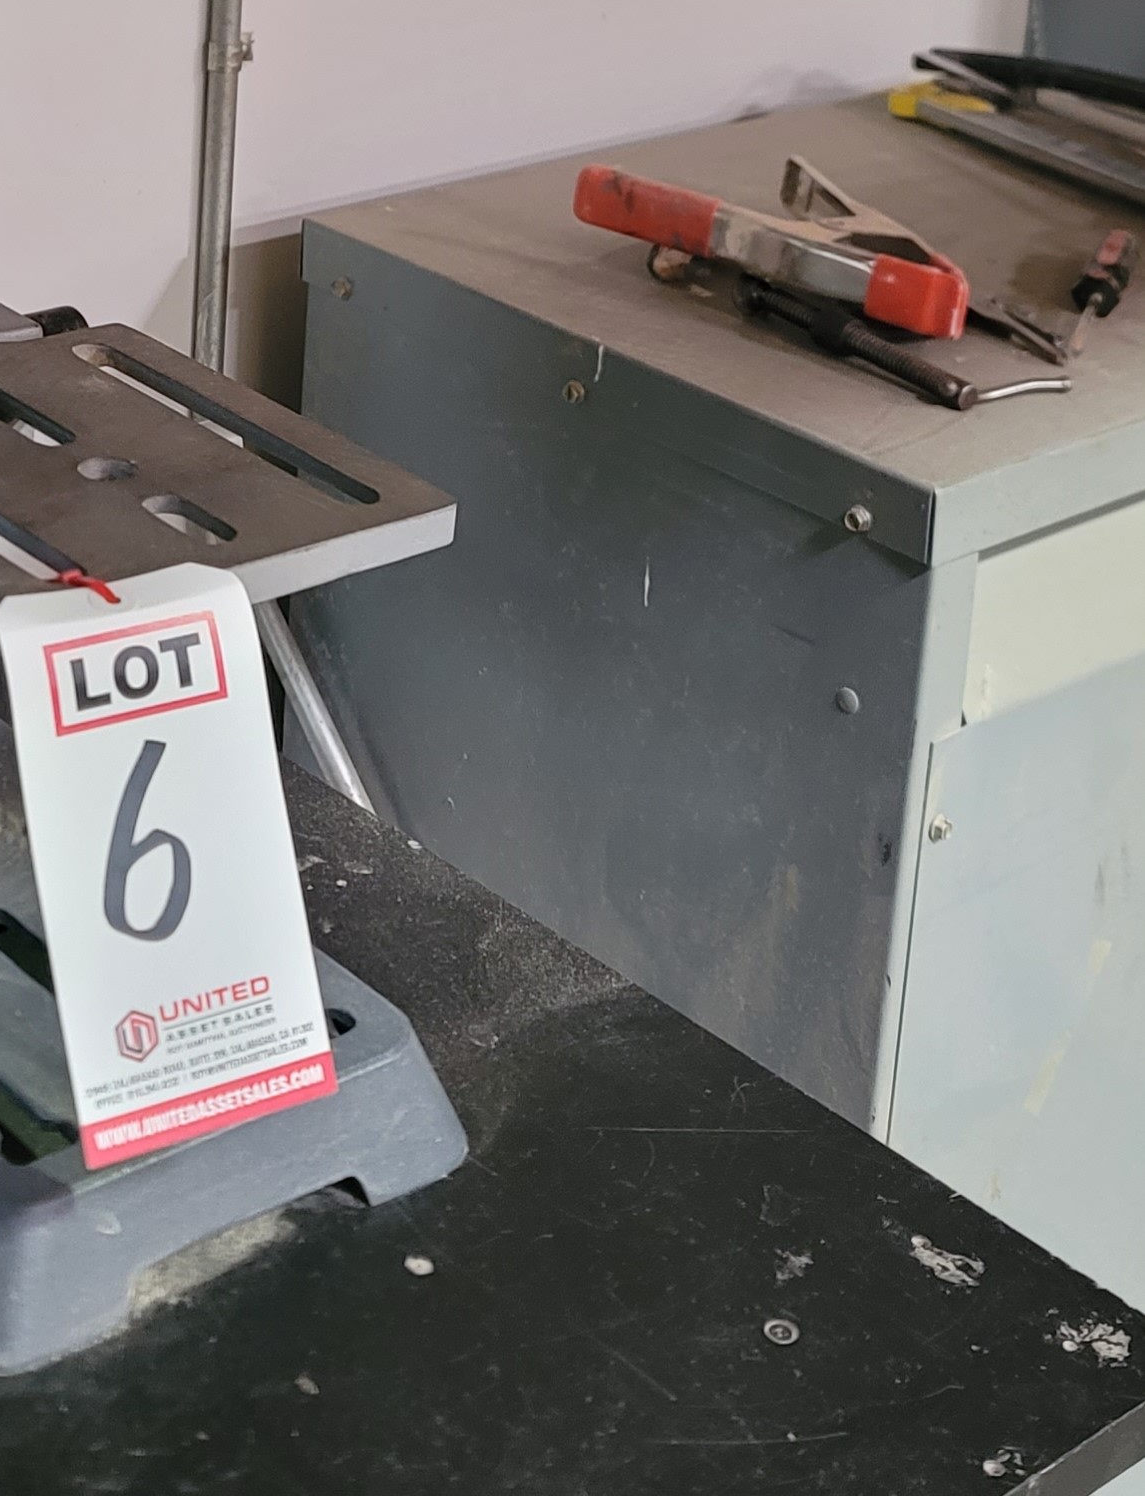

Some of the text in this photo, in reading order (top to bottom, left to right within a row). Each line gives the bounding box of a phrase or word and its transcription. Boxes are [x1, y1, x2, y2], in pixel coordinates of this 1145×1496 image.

[69, 632, 201, 711] LOT
[103, 739, 191, 942] 6
[159, 975, 270, 1022] UNITED
[165, 1019, 219, 1042] ASSET
[223, 1003, 274, 1028] SALES
[93, 1063, 325, 1151] WWW.UNITEDASSETSALES.COM
